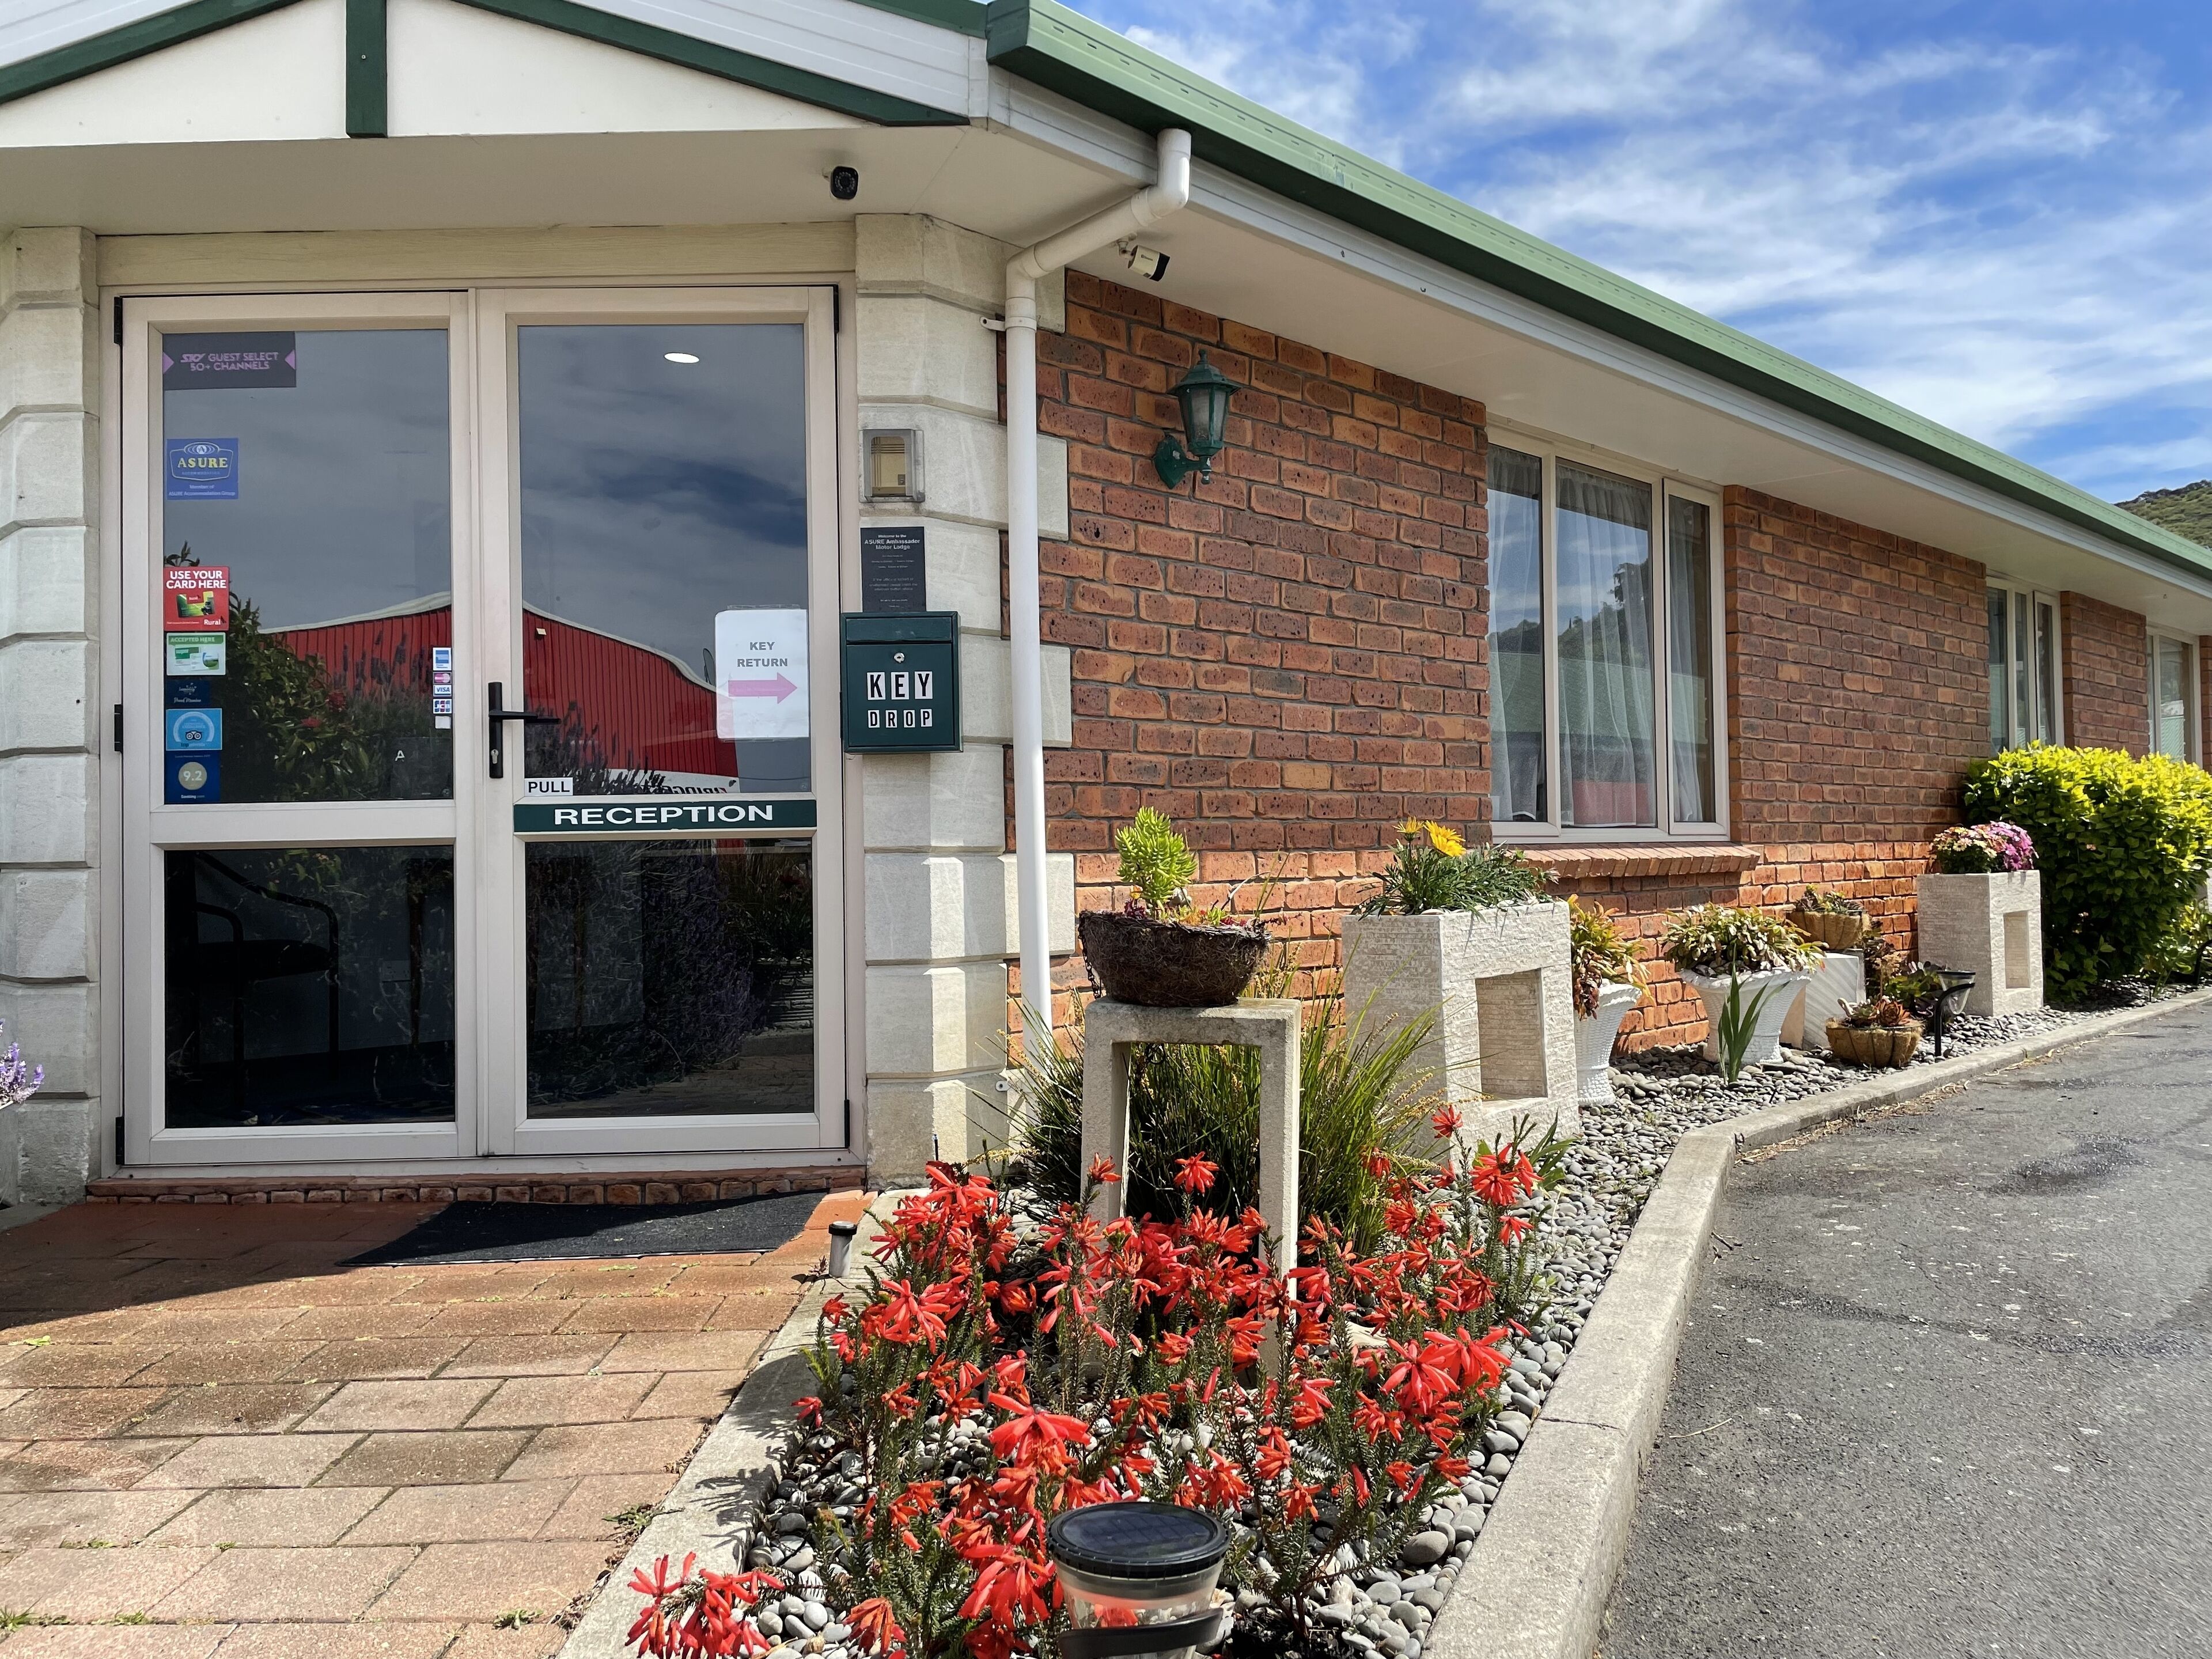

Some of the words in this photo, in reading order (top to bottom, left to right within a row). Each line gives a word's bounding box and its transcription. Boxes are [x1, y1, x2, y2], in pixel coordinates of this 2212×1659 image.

[208, 353, 241, 362] GUEST
[243, 351, 279, 361] SELECT
[190, 363, 210, 371] 50+
[213, 361, 270, 370] CHANNELS
[177, 457, 228, 468] ASURE
[170, 571, 191, 579] USE
[192, 570, 222, 579] YOUR
[166, 580, 196, 589] CARD
[198, 579, 227, 589] HERE
[749, 642, 775, 650] KEY
[737, 658, 788, 667] RETURN
[870, 673, 930, 698] KEY
[870, 710, 930, 726] DROP
[183, 770, 202, 781] 9.2
[528, 781, 570, 793] PULL
[554, 805, 773, 825] RECEPTION
